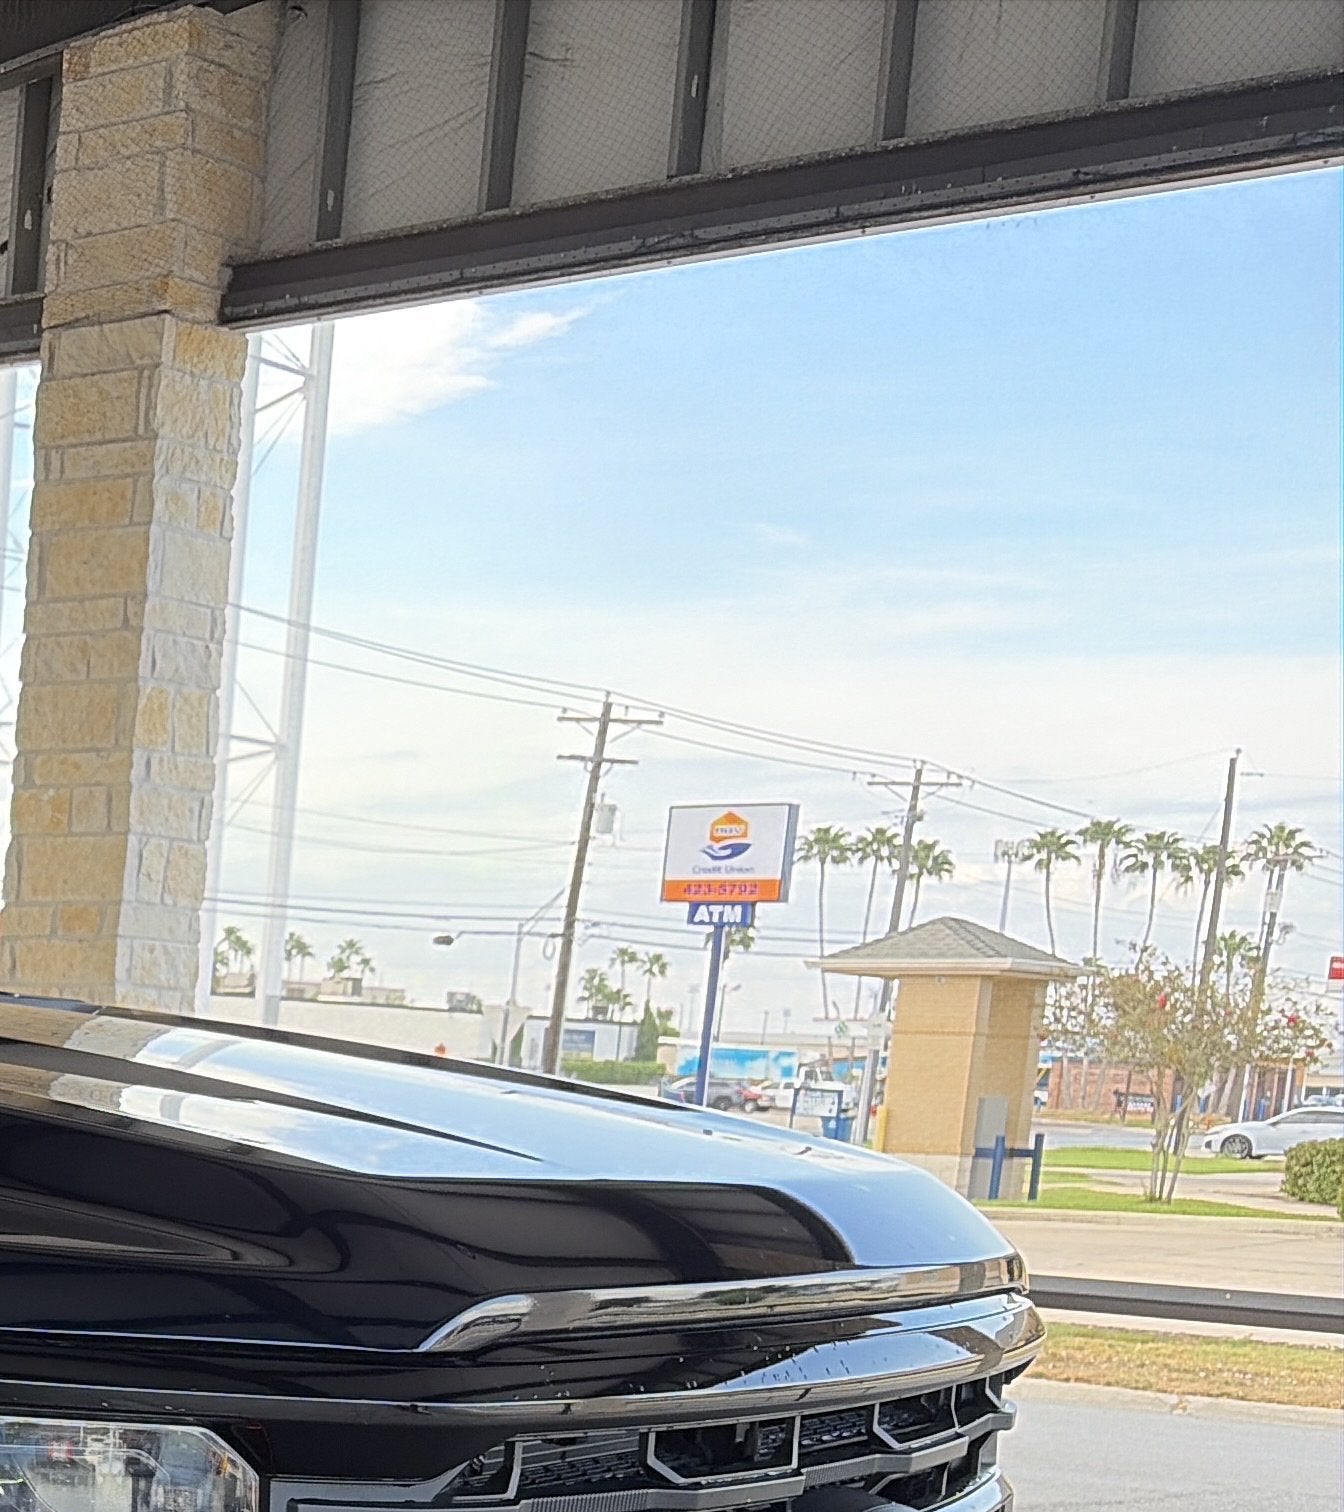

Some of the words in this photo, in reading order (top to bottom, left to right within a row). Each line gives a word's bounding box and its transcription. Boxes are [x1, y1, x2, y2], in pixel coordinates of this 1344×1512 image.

[692, 865, 722, 874] Credit
[724, 864, 755, 874] Union
[693, 904, 743, 923] ATM
